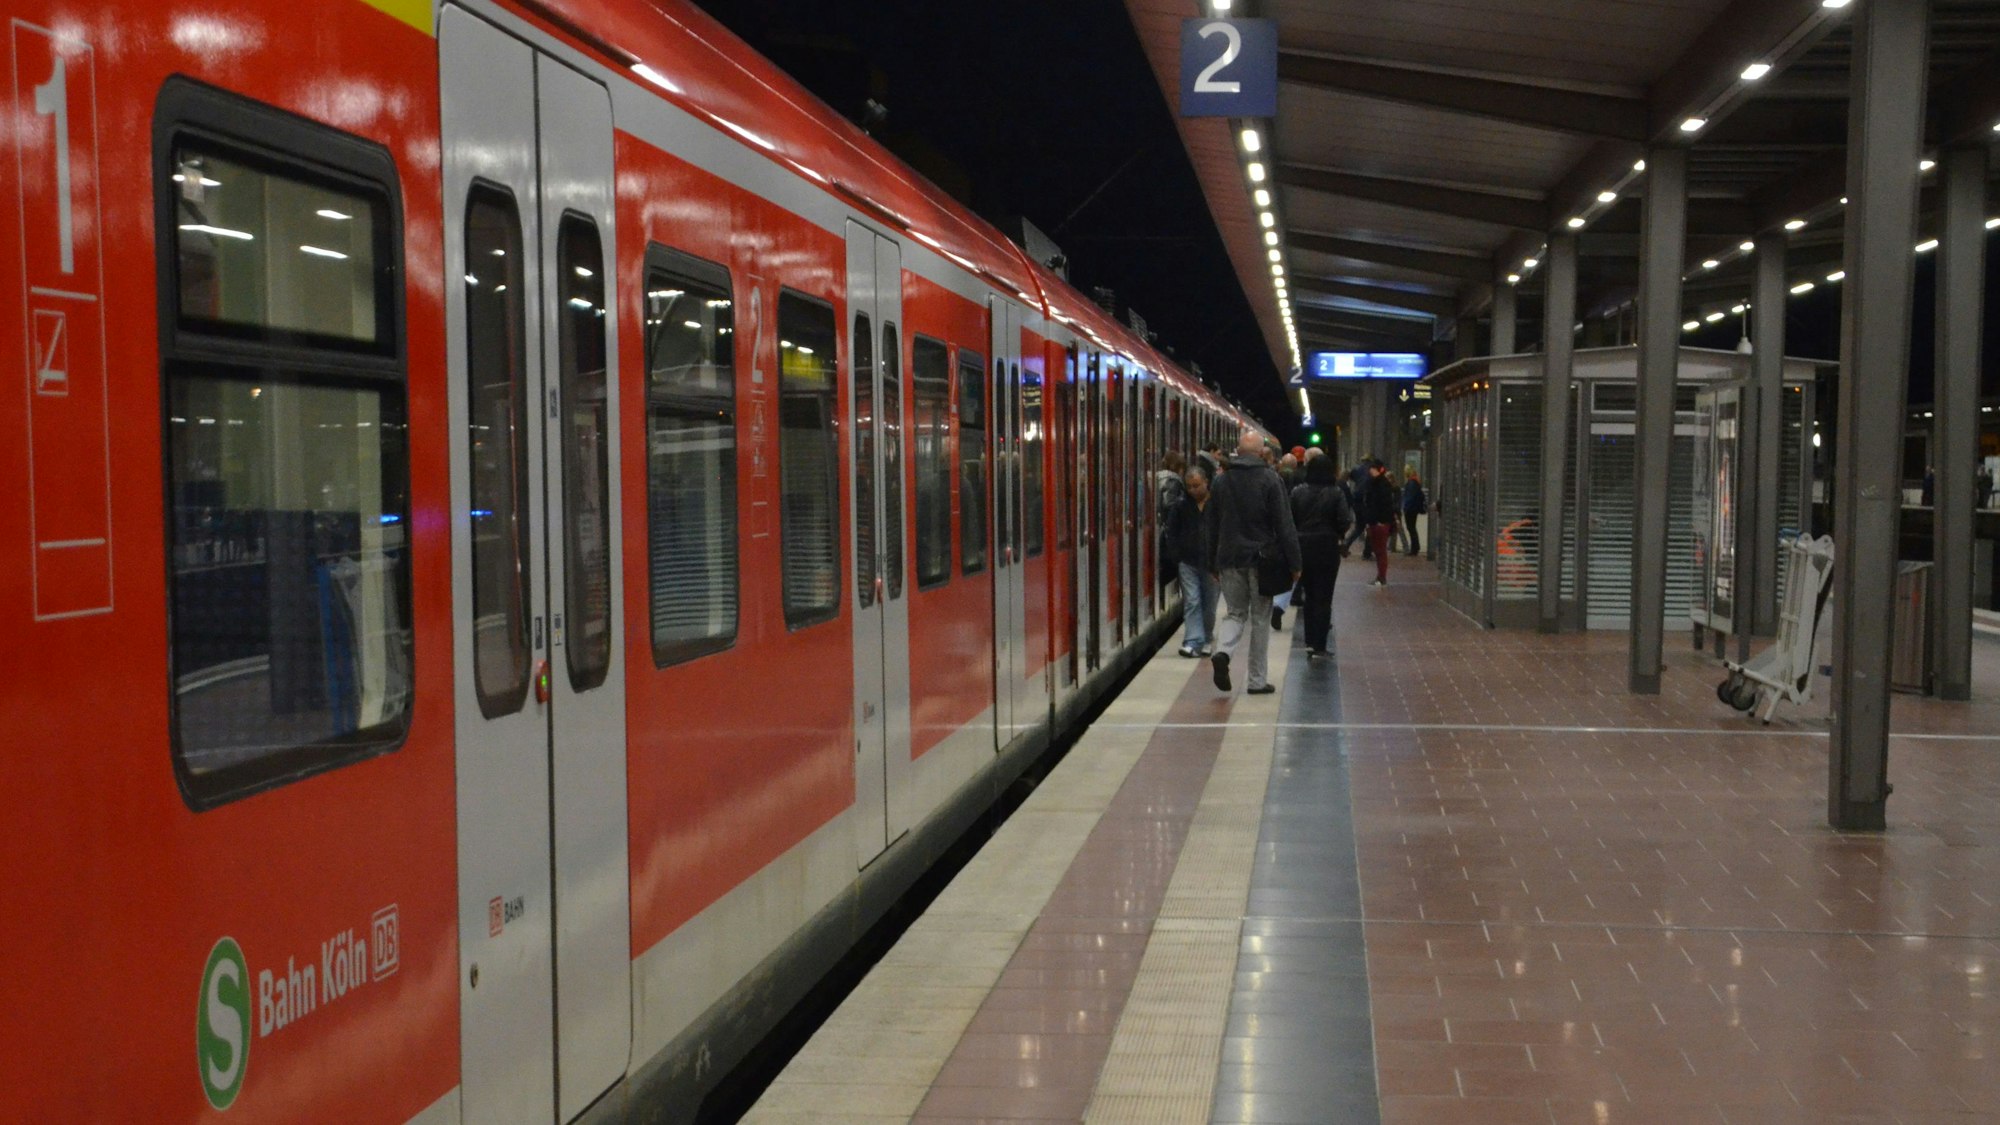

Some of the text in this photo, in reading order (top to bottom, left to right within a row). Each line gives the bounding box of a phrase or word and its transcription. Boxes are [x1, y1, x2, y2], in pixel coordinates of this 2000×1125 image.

[1194, 22, 1241, 93] 2
[35, 56, 73, 274] 1
[751, 286, 764, 383] 2
[1290, 367, 1303, 383] 2
[1320, 360, 1328, 371] 2
[1302, 415, 1311, 425] 2
[505, 896, 524, 924] BAHN
[208, 913, 398, 1090] S Bahn Köln DB
